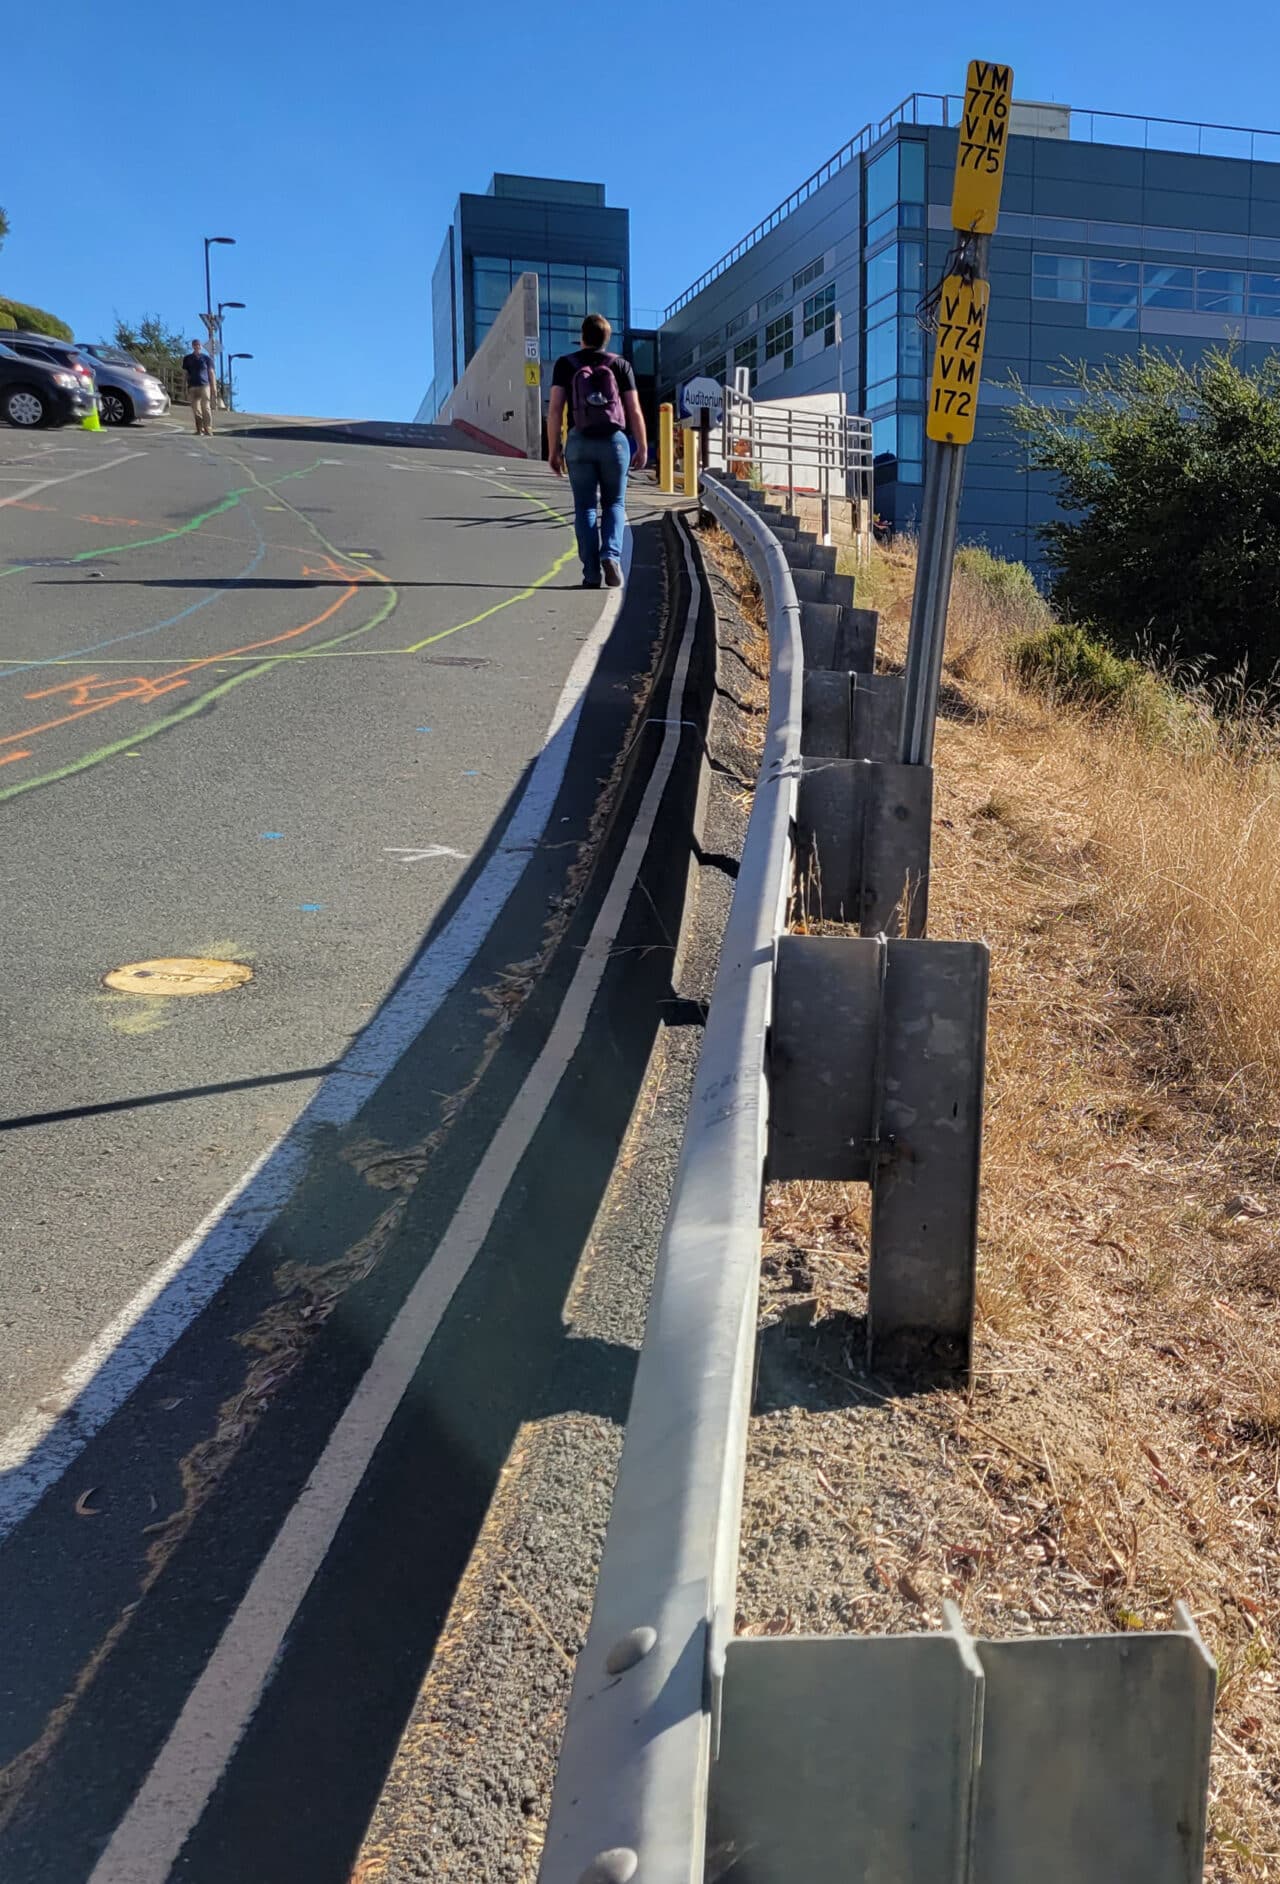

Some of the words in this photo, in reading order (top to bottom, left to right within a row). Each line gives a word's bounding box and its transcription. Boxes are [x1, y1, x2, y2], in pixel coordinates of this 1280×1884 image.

[975, 61, 1009, 92] VM
[967, 87, 1007, 118] 776
[961, 141, 1000, 173] 775
[940, 323, 981, 353] 774
[941, 354, 976, 385] VM
[934, 388, 971, 416] 172
